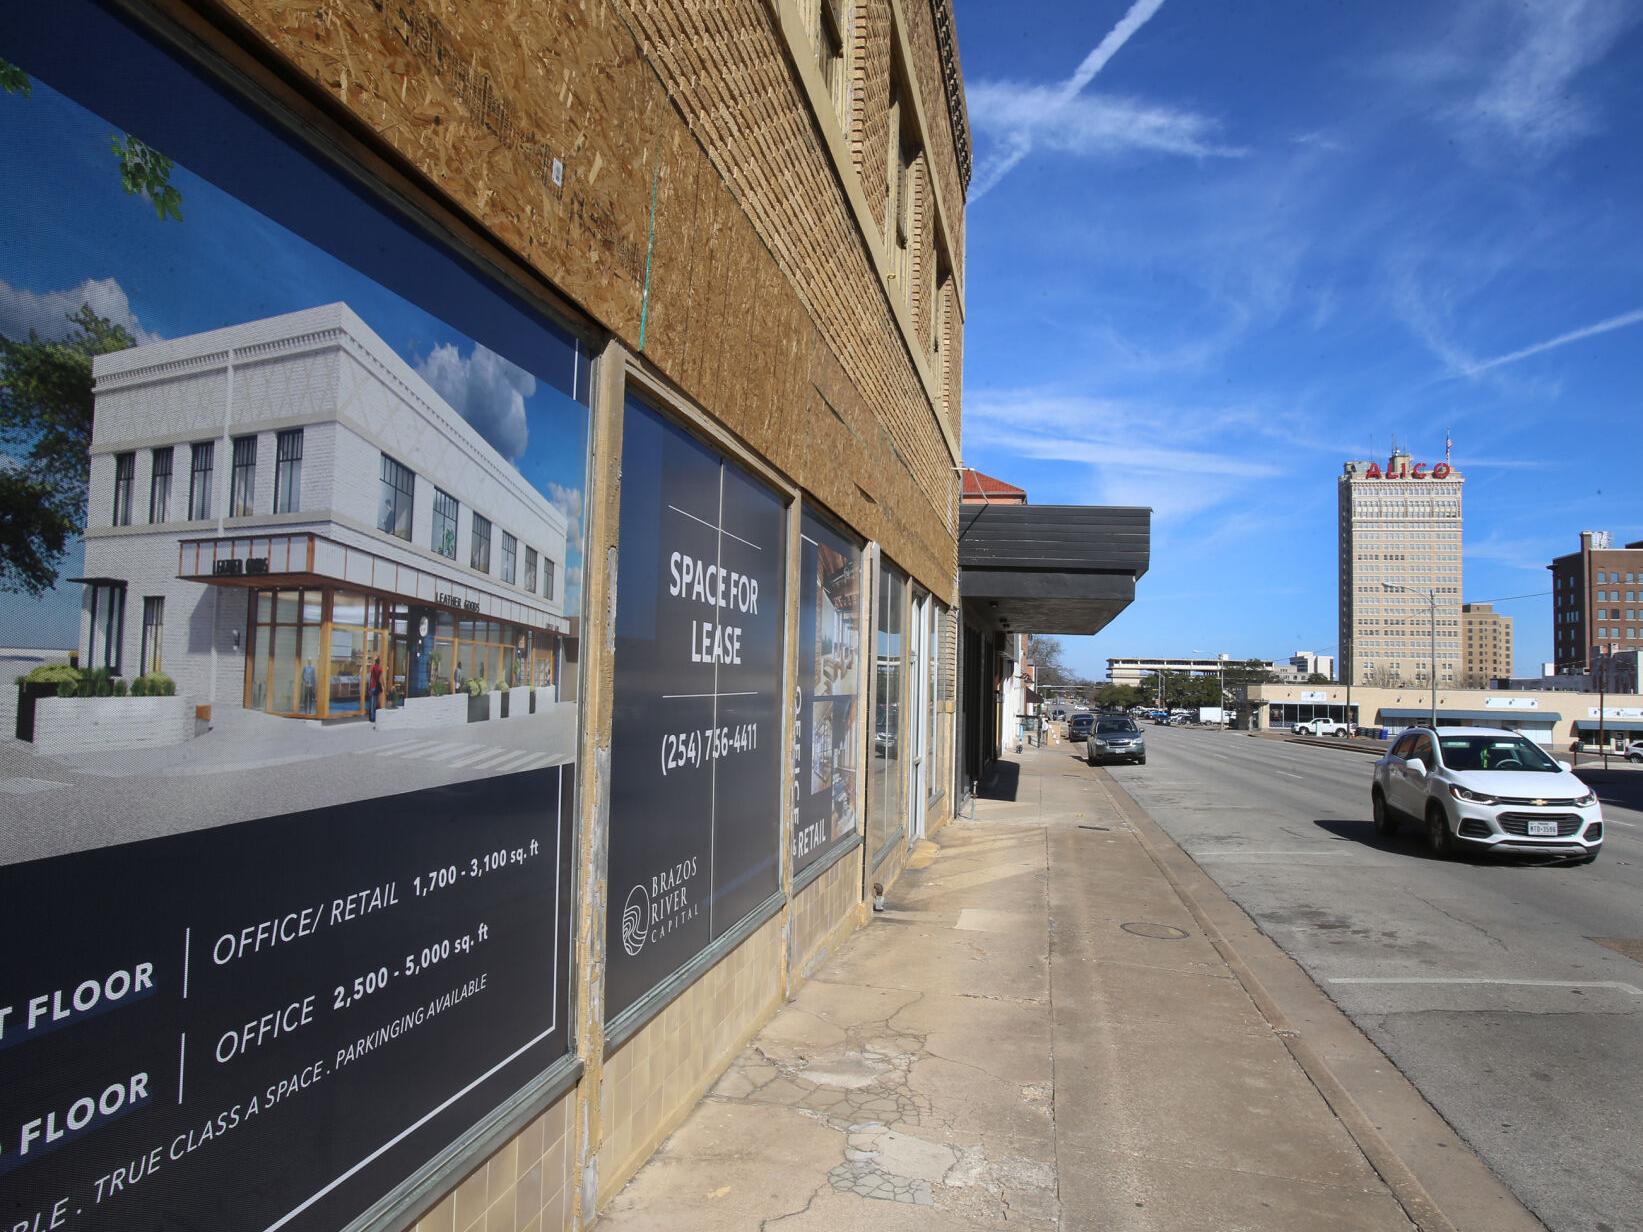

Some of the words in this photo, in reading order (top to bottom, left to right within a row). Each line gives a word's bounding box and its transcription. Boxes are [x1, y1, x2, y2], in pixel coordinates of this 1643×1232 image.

[1365, 463, 1451, 480] ALICO
[669, 551, 727, 608] SPACE
[730, 571, 759, 615] FOR
[691, 620, 742, 665] LEASE
[661, 730, 702, 776] (254)
[705, 722, 757, 761] 756-4411
[798, 818, 827, 860] RETAIL
[651, 856, 697, 898] BRAZOS
[651, 887, 688, 926] RIVER
[651, 903, 699, 943] CAPITAL
[28, 962, 153, 1030] FLOOR
[213, 904, 324, 965] OFFICE/
[330, 881, 399, 926] RETAIL
[413, 866, 457, 897] 1,700
[470, 850, 507, 877] 3,100
[510, 848, 527, 865] sq.
[530, 839, 539, 856] ft
[20, 1072, 149, 1156] FLOOR
[215, 995, 316, 1064] OFFICE
[333, 966, 388, 1010] 2,500
[405, 939, 450, 976] 5,000
[454, 935, 475, 954] sq.
[478, 922, 489, 942] ft
[94, 1146, 163, 1204] TRUE
[169, 1104, 241, 1160] CLASS
[244, 1095, 259, 1121] A
[264, 1060, 324, 1108] SPACE
[335, 1007, 424, 1070] PARKINGING
[426, 973, 488, 1020] AVAILABLE
